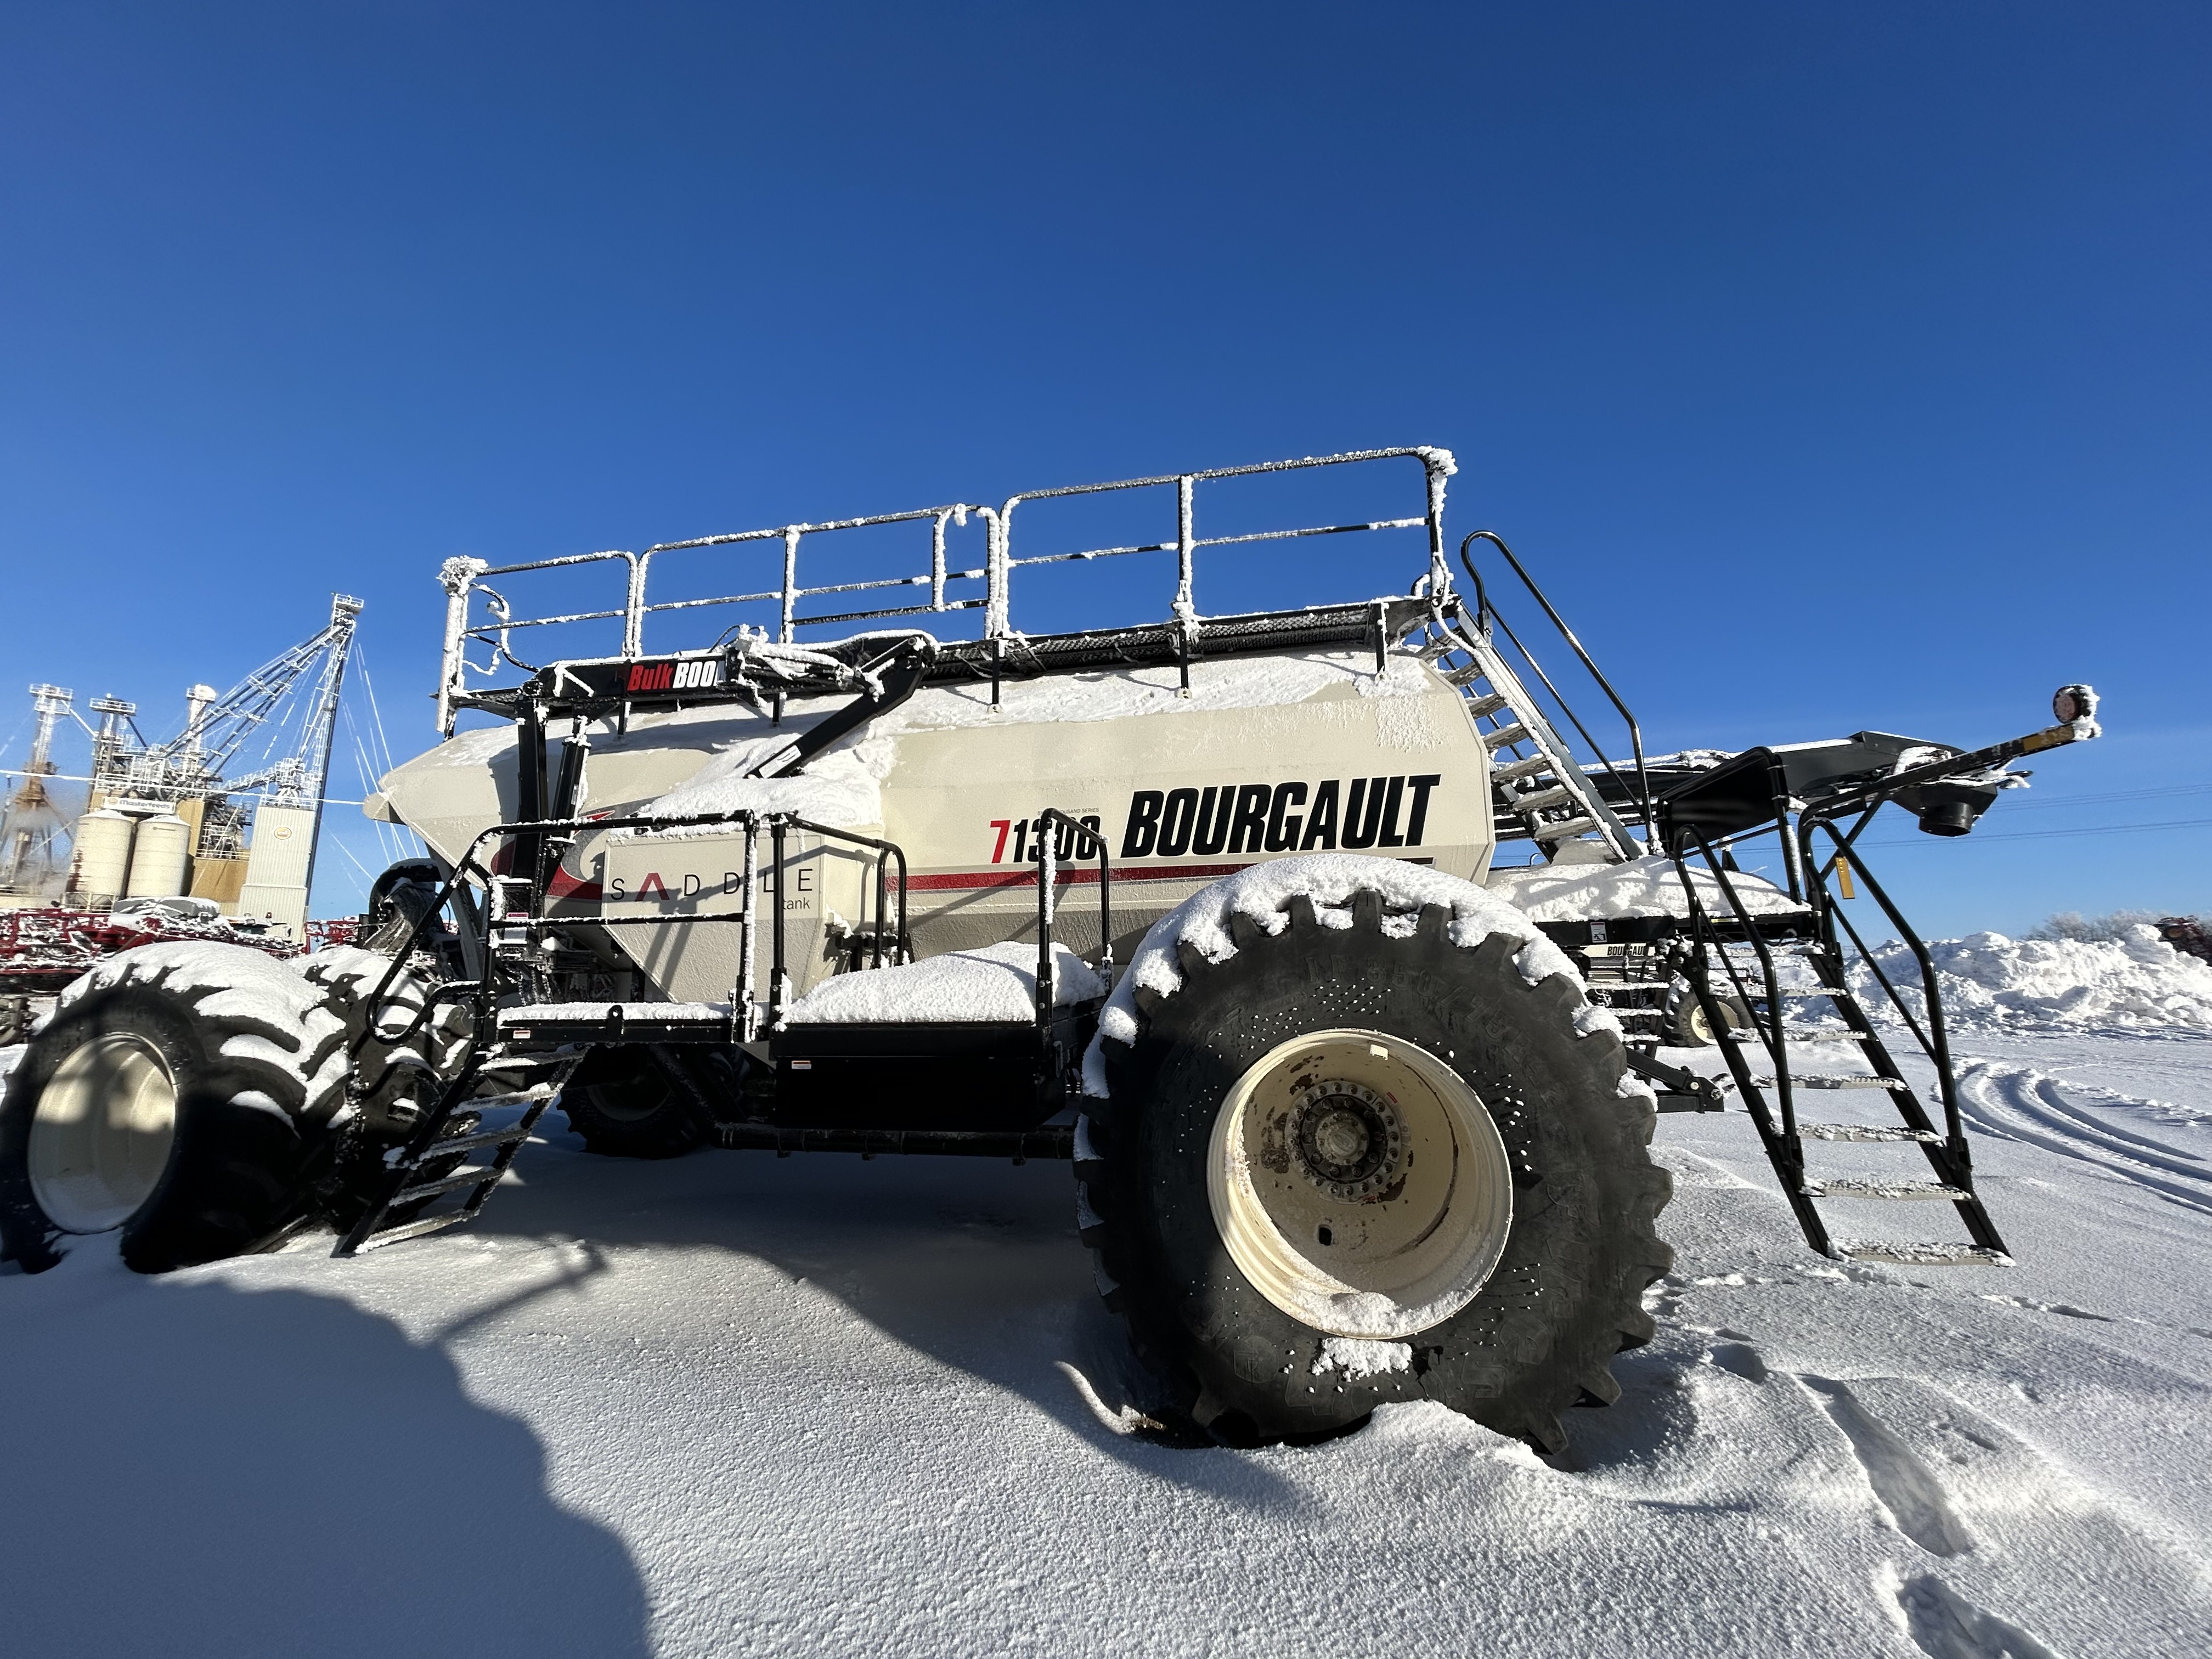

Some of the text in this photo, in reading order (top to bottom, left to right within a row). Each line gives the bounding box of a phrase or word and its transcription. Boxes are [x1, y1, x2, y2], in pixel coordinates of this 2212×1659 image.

[1120, 774, 1440, 858] BOURGAULT
[611, 868, 813, 902] SADDLE
[1607, 946, 1644, 956] BOUGAU
